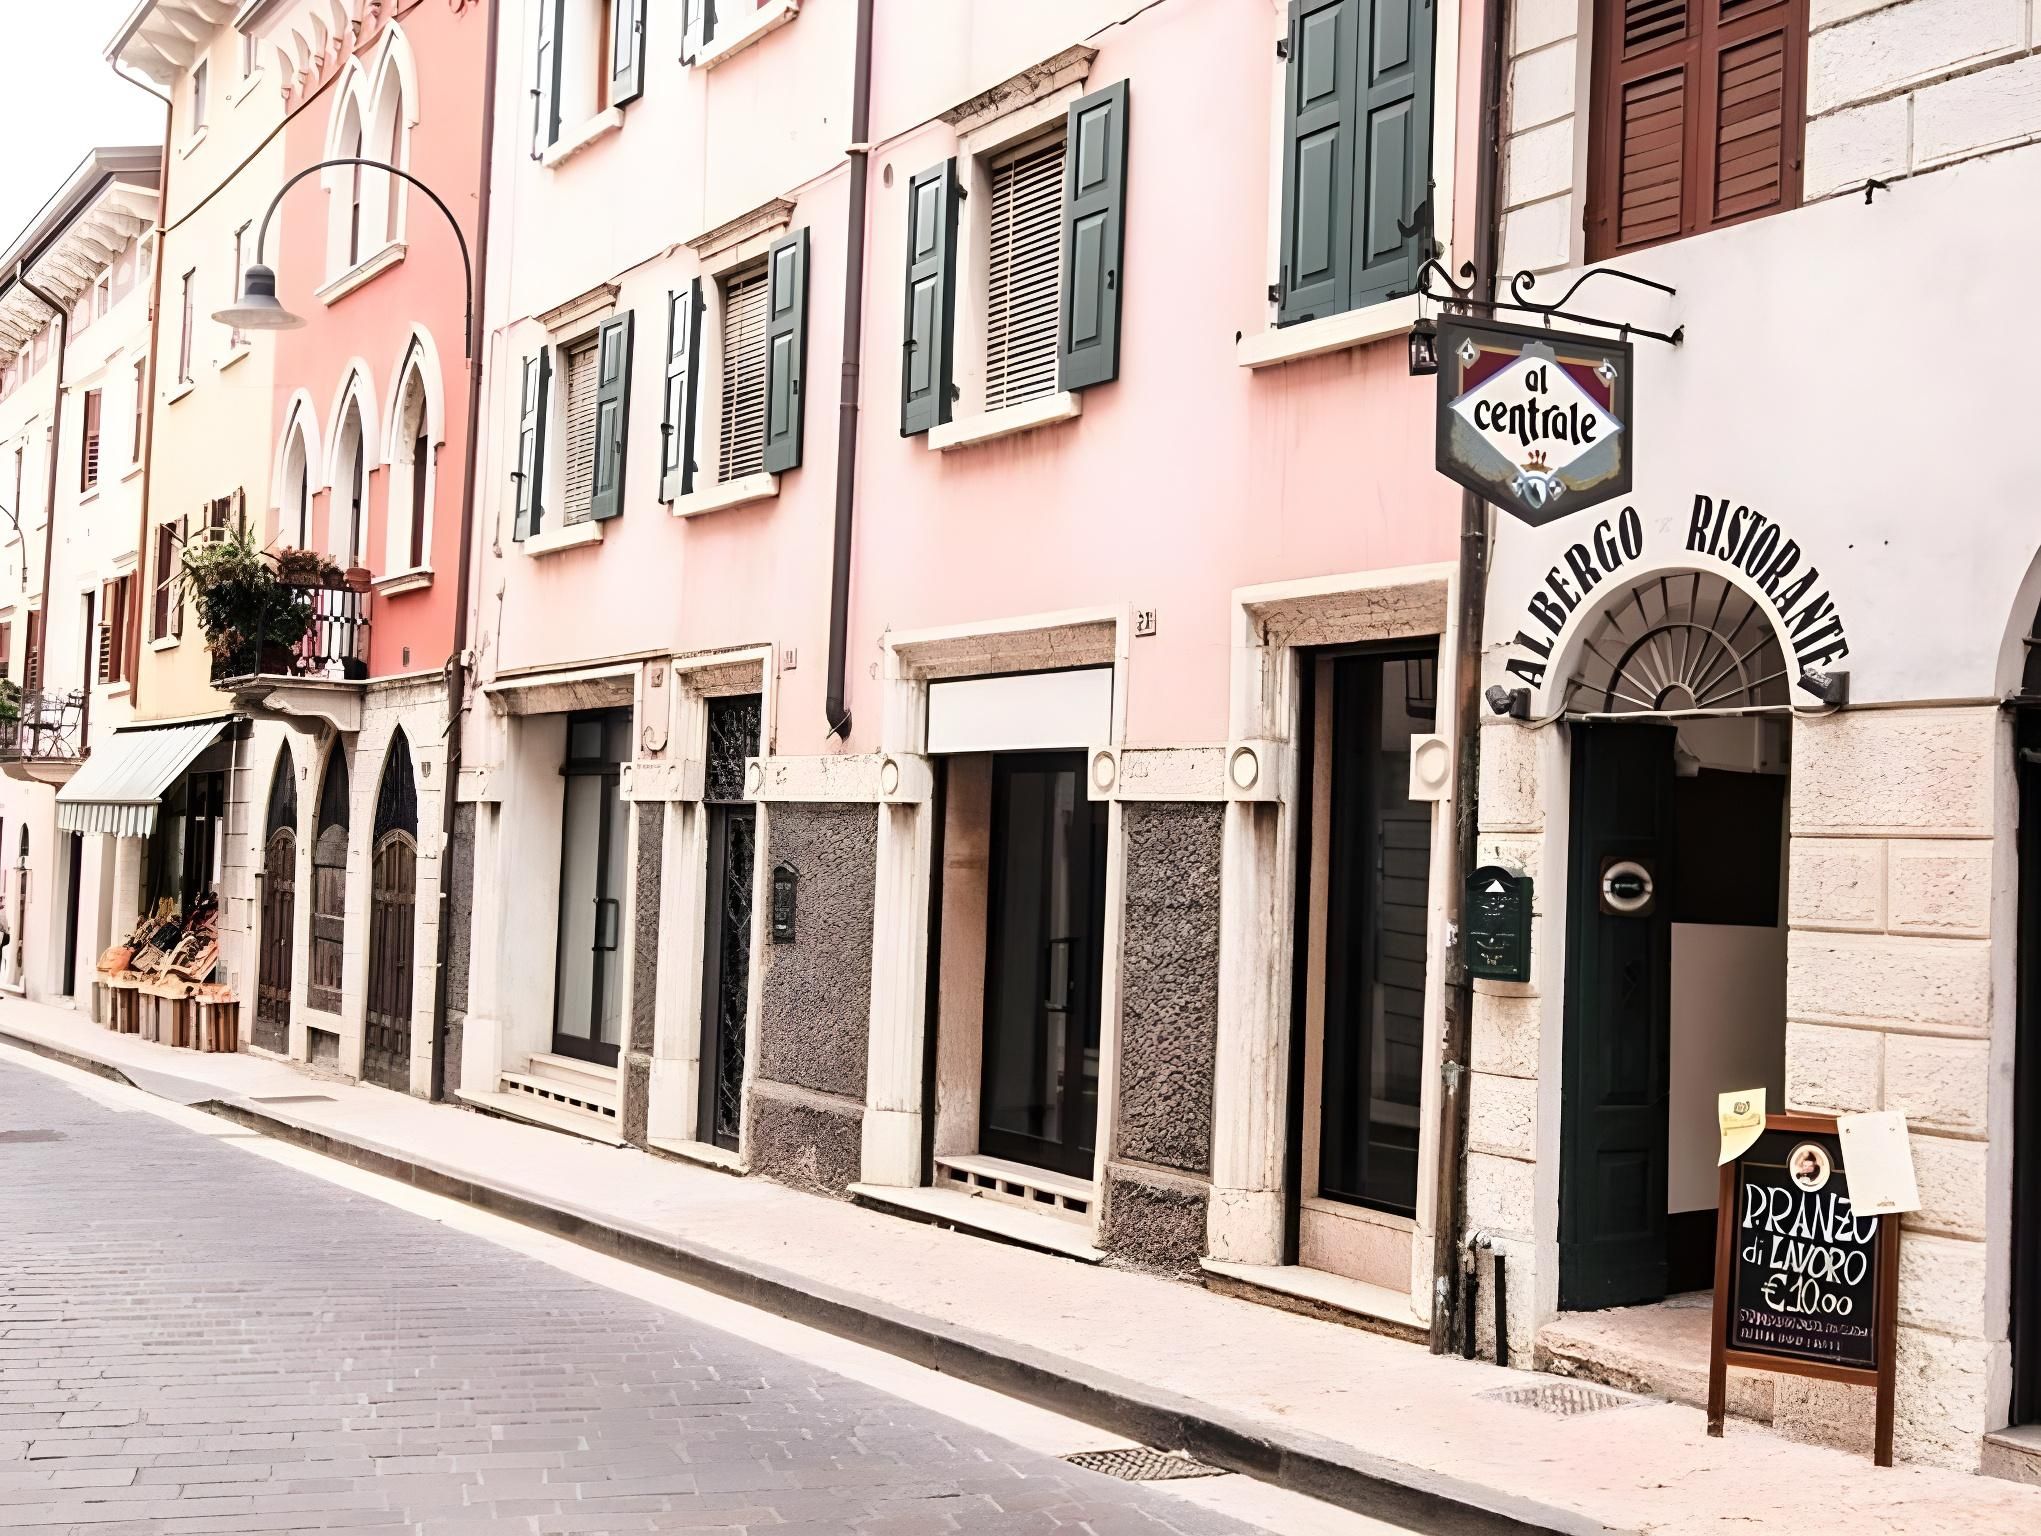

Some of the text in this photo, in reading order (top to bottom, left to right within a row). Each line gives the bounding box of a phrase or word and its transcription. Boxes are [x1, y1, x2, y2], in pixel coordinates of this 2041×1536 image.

[1525, 365, 1548, 395] al
[1474, 397, 1597, 447] centrale
[1505, 494, 1849, 690] ALBERGO RISTORANTE
[1742, 1235, 1867, 1286] di LAVORO
